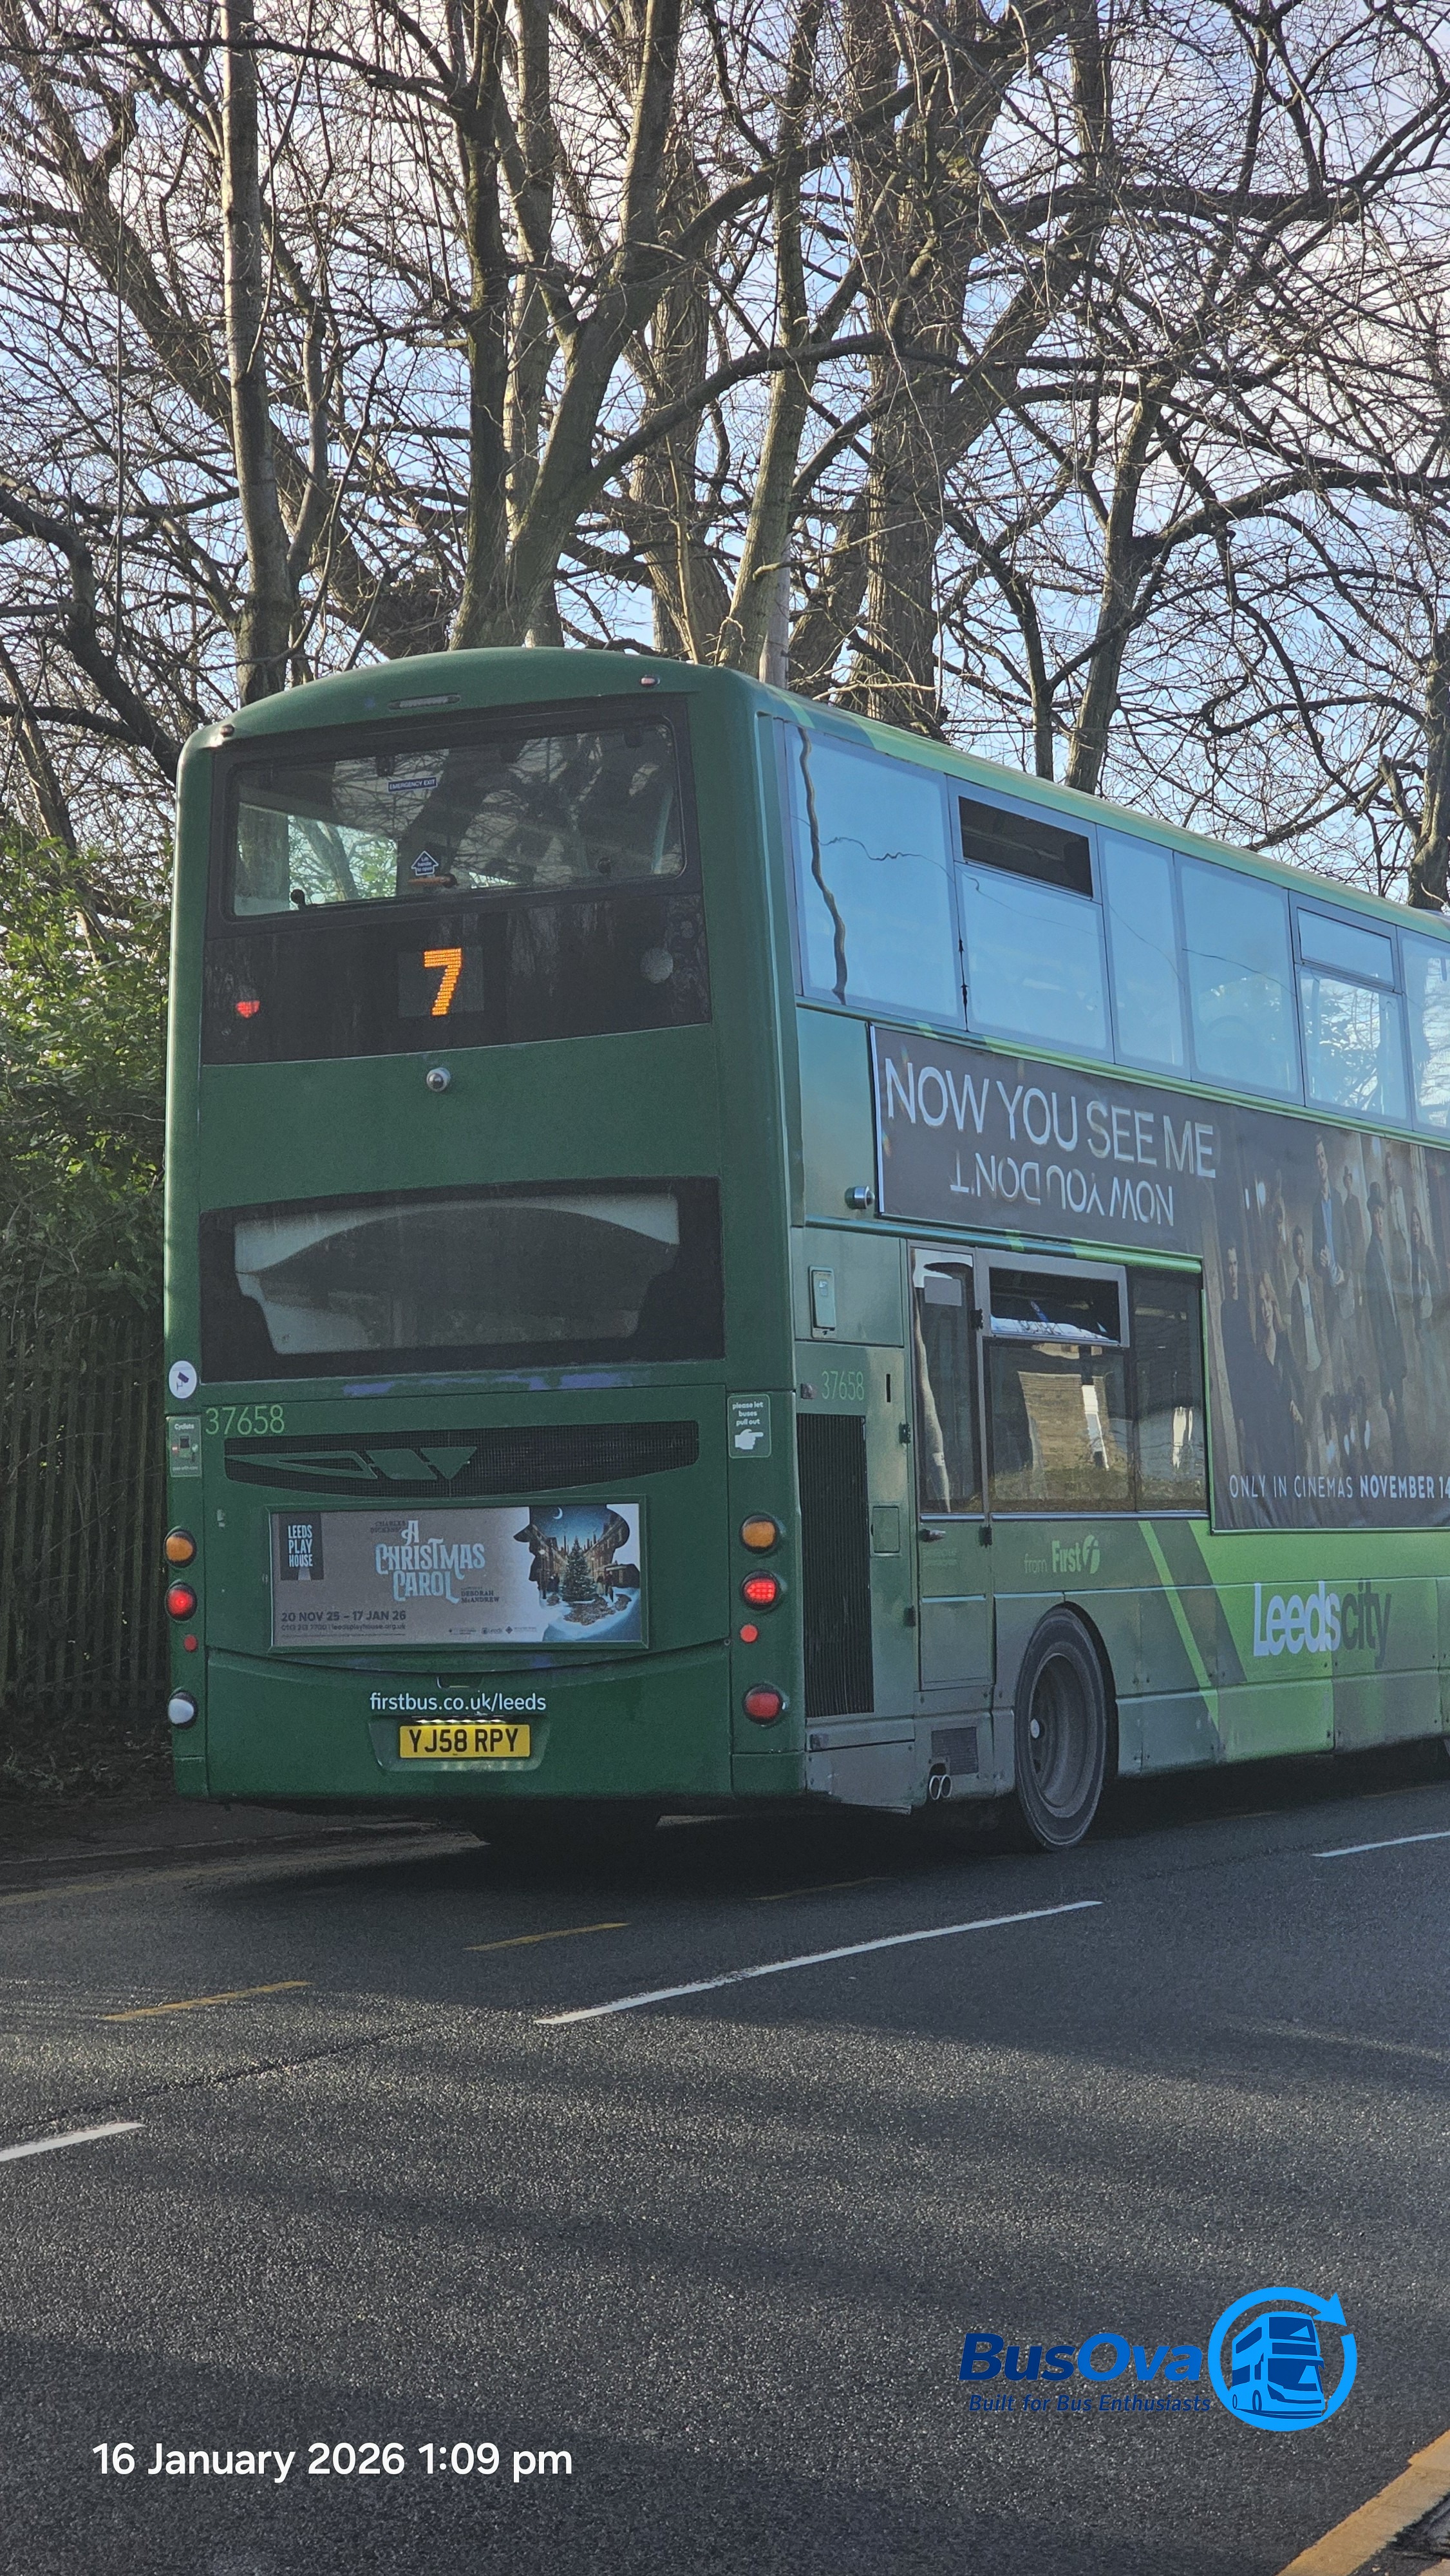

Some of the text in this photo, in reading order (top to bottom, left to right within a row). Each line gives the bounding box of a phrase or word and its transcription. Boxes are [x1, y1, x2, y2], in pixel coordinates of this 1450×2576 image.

[390, 781, 422, 790] EMERGENCY
[424, 948, 462, 1016] 7
[885, 1058, 1216, 1179] NOW YOU SEE ME
[822, 1370, 865, 1401] 37658
[205, 1405, 285, 1435] 37658
[1229, 1474, 1450, 1499] ONLY IN CINEMAS NOVEMBER 14
[288, 1524, 312, 1539] LEEDS
[400, 1520, 419, 1545] A
[288, 1539, 313, 1554] PLAY
[375, 1538, 486, 1580] CHRISTMAS
[1024, 1540, 1082, 1573] from First
[289, 1554, 314, 1567] HOUSE
[393, 1570, 460, 1604] CAROL
[281, 1612, 296, 1622] 20
[299, 1611, 324, 1622] NOV
[326, 1611, 340, 1621] 25
[353, 1611, 364, 1620] 17
[366, 1611, 389, 1620] JAN
[392, 1610, 406, 1620] 26
[370, 1692, 546, 1711] firstbus.co.uk/leeds
[409, 1728, 518, 1752] YJ58 RPY
